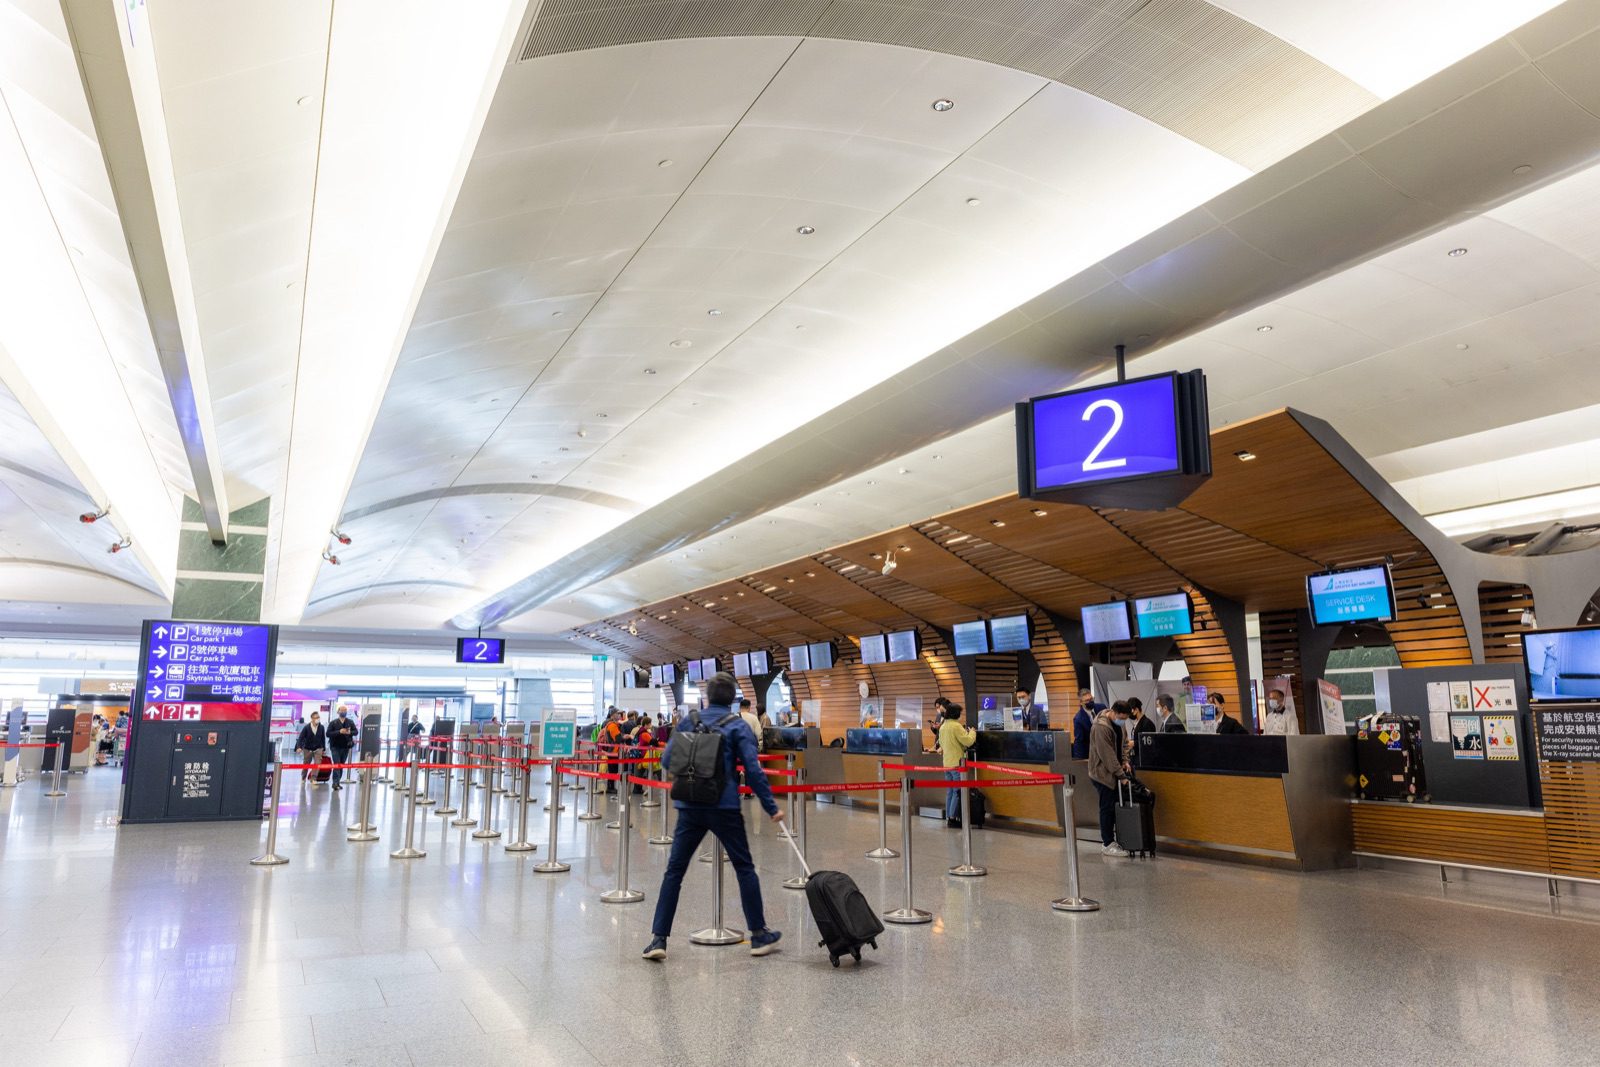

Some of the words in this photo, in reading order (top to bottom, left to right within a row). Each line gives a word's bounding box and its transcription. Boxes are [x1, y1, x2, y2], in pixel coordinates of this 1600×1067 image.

[1081, 399, 1127, 472] 2
[1325, 596, 1354, 607] SERVICE
[1355, 594, 1376, 603] DESK
[203, 636, 219, 644] park
[474, 641, 488, 660] 2
[189, 654, 202, 662] Car
[203, 655, 218, 663] park
[186, 675, 214, 683] Skytrain
[1543, 725, 1600, 735] 完成安檢無
[1044, 734, 1053, 743] 15
[1142, 735, 1152, 745] 16
[1568, 744, 1593, 752] baggage
